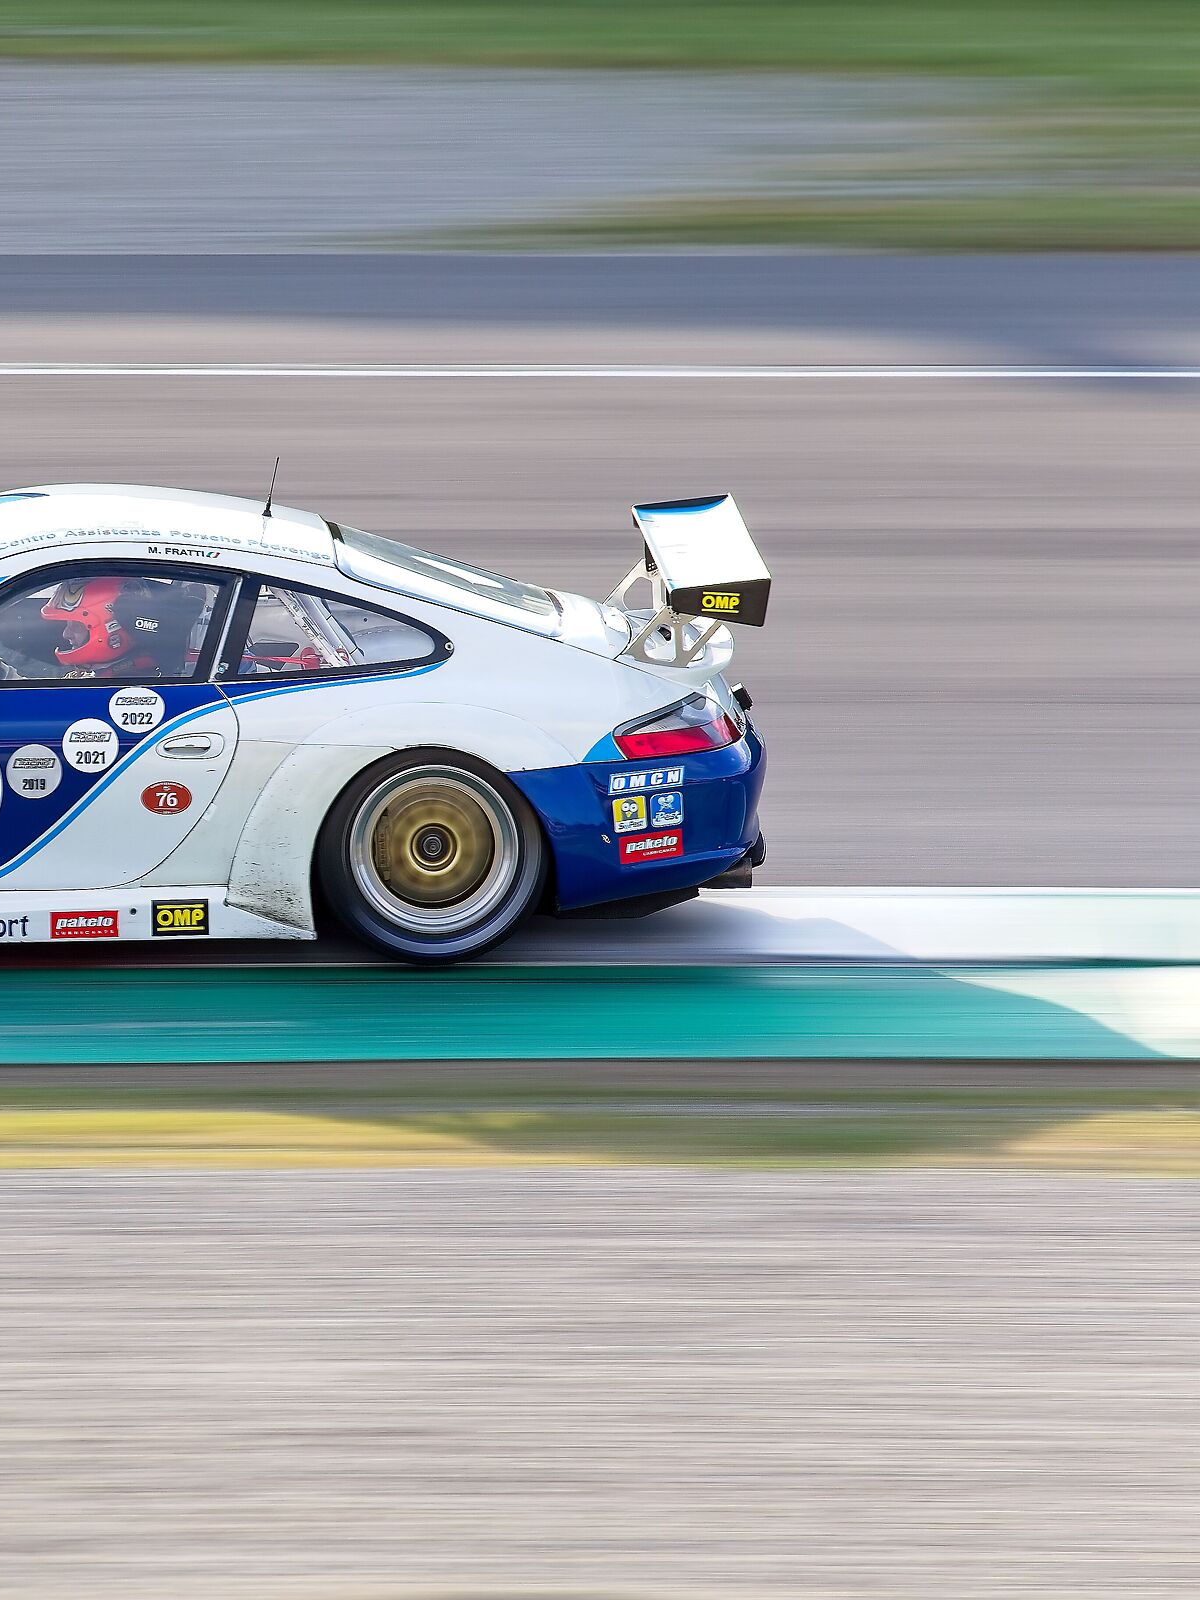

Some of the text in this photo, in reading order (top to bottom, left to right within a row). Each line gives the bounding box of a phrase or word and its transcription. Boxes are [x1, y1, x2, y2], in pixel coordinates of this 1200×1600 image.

[170, 530, 242, 545] Porsche
[147, 546, 205, 558] M. FRATTI
[701, 595, 740, 610] OMP
[135, 619, 159, 631] OMP
[121, 712, 153, 726] 2022
[75, 751, 106, 765] 2021
[22, 778, 46, 790] 2019
[612, 770, 680, 790] OMCN
[155, 792, 179, 807] 76
[625, 836, 679, 854] pakelo
[55, 916, 115, 930] pakelo
[156, 908, 205, 927] OMP
